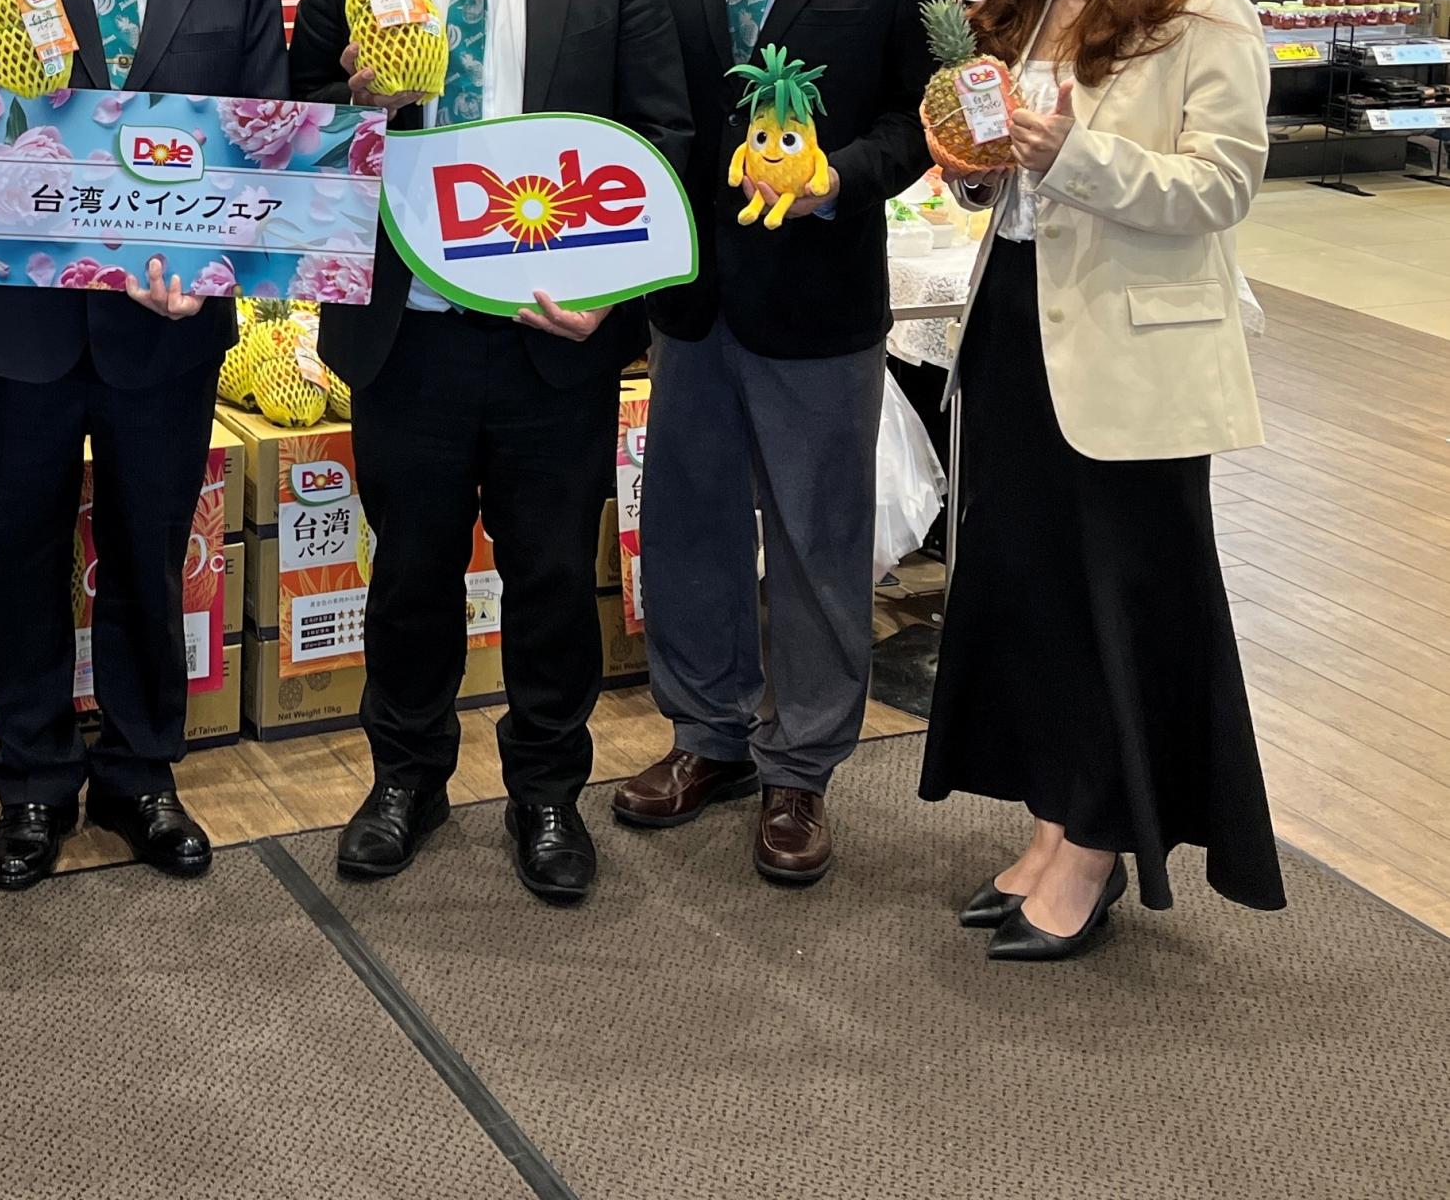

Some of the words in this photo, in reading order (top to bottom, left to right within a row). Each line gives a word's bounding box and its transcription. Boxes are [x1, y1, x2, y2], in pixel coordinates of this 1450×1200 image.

[969, 68, 996, 84] Dole
[133, 137, 194, 166] Dole
[31, 184, 283, 221] 台湾パインフェア
[432, 149, 647, 250] Dole
[71, 218, 238, 235] TAIWAN-PINEAPPLE
[301, 468, 345, 490] Dole
[292, 508, 350, 543] 台湾
[298, 539, 346, 558] パイン
[278, 712, 291, 721] Net
[293, 708, 321, 720] Weight
[323, 705, 342, 715] 10kg
[187, 726, 198, 739] of
[199, 724, 229, 737] Taiwan
